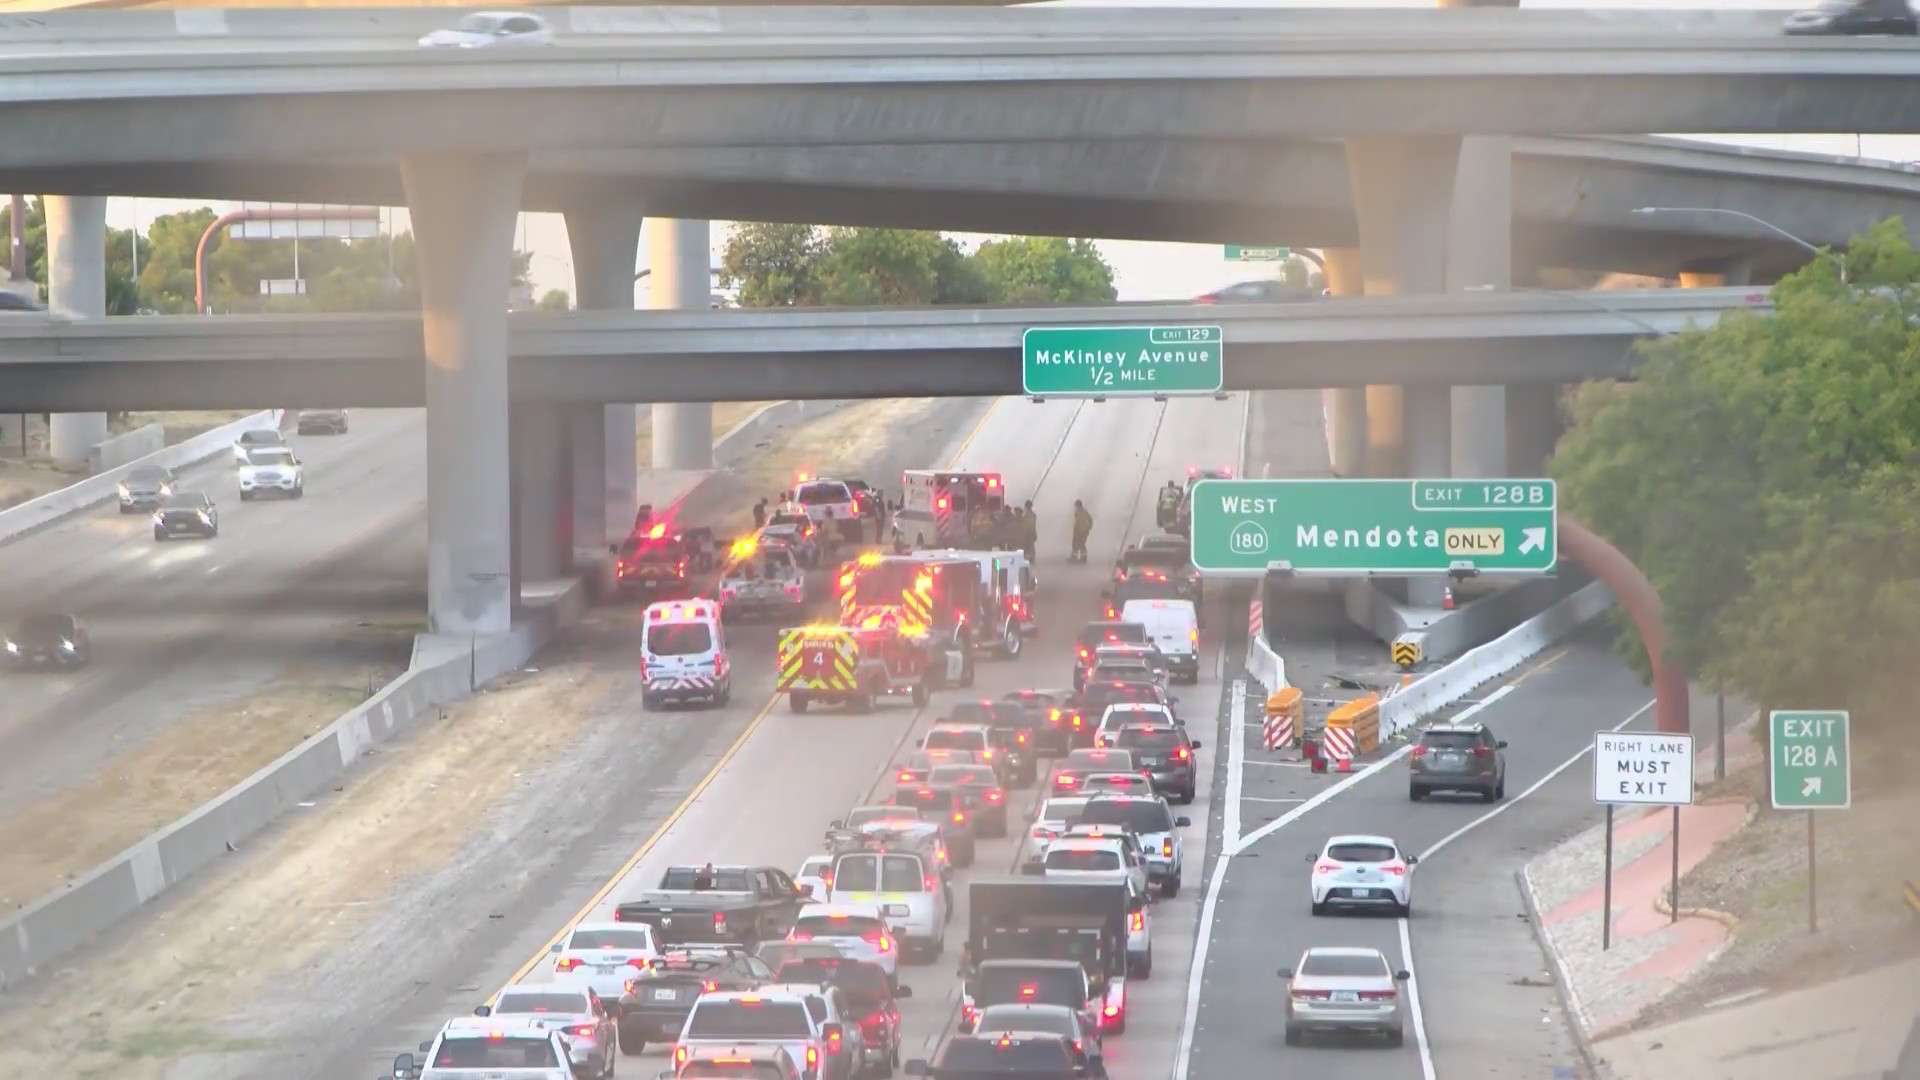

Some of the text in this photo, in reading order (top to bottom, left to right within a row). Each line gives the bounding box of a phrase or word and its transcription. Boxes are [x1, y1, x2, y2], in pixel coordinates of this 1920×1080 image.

[1162, 329, 1210, 340] EXIT 129
[1036, 349, 1209, 366] McKinley Avenue
[1121, 369, 1156, 381] MILE
[1425, 486, 1544, 504] EXIT 128B
[1221, 496, 1278, 514] WEST
[1235, 533, 1264, 548] 180
[1297, 525, 1440, 548] Mendota
[1447, 534, 1501, 549] ONLY
[813, 651, 824, 665] 4
[1784, 719, 1836, 737] EXIT
[1604, 741, 1684, 754] RIGHT LANE
[1783, 745, 1838, 767] 128 A
[1617, 760, 1671, 774] MUST
[1620, 781, 1667, 795] EXIT
